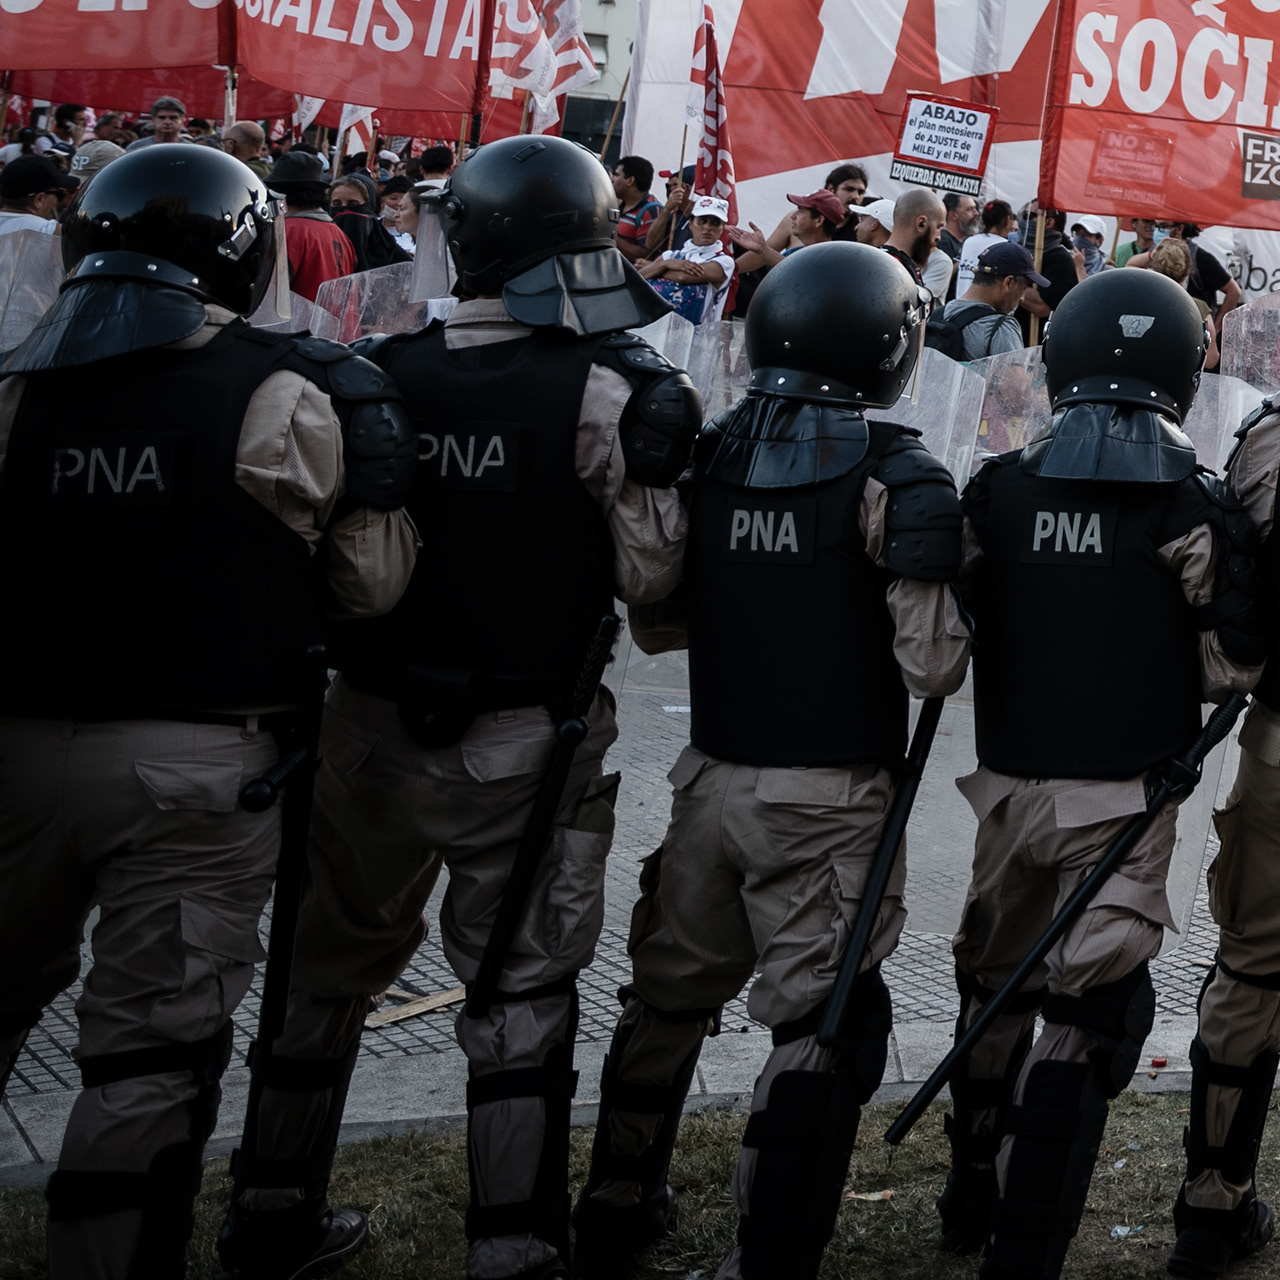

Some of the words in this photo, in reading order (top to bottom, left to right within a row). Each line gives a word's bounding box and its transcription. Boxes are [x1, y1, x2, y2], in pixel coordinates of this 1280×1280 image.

[909, 117, 917, 127] el
[918, 119, 937, 131] plan
[938, 124, 984, 141] motosierra
[921, 104, 978, 126] ABAJO
[912, 143, 935, 157] MILEI
[936, 150, 943, 160] y
[943, 148, 951, 160] el
[953, 151, 969, 163] FMI
[914, 131, 926, 142] de
[926, 135, 959, 149] AJUSTE
[960, 140, 971, 151] de
[891, 162, 935, 186] IZQUIERDA
[934, 172, 980, 195] SOCIALISTA
[53, 446, 165, 495] PNA
[415, 433, 504, 478] PNA
[730, 509, 799, 554] PNA
[1032, 511, 1103, 555] PNA
